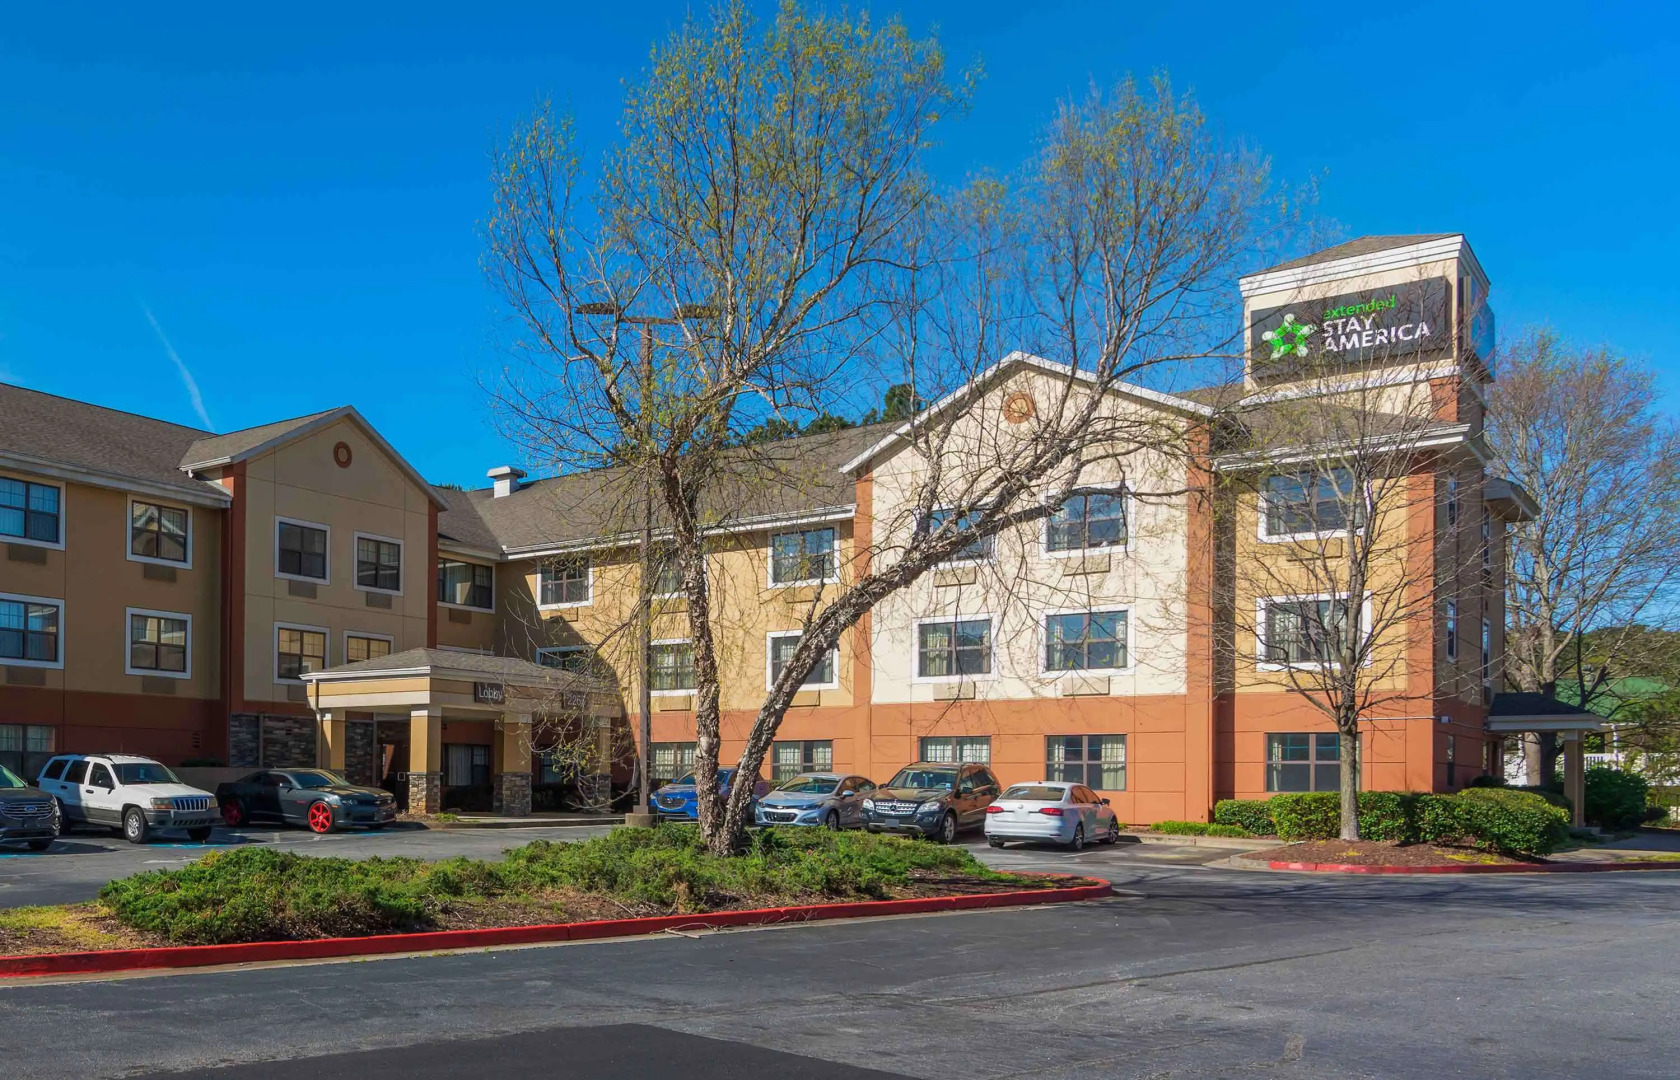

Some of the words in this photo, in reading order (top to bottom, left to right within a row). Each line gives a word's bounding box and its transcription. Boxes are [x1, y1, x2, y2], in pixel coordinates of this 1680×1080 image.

[1323, 295, 1396, 319] extended
[1322, 313, 1376, 338] STAY
[1325, 321, 1431, 352] AMERICA
[478, 685, 503, 702] Lobby
